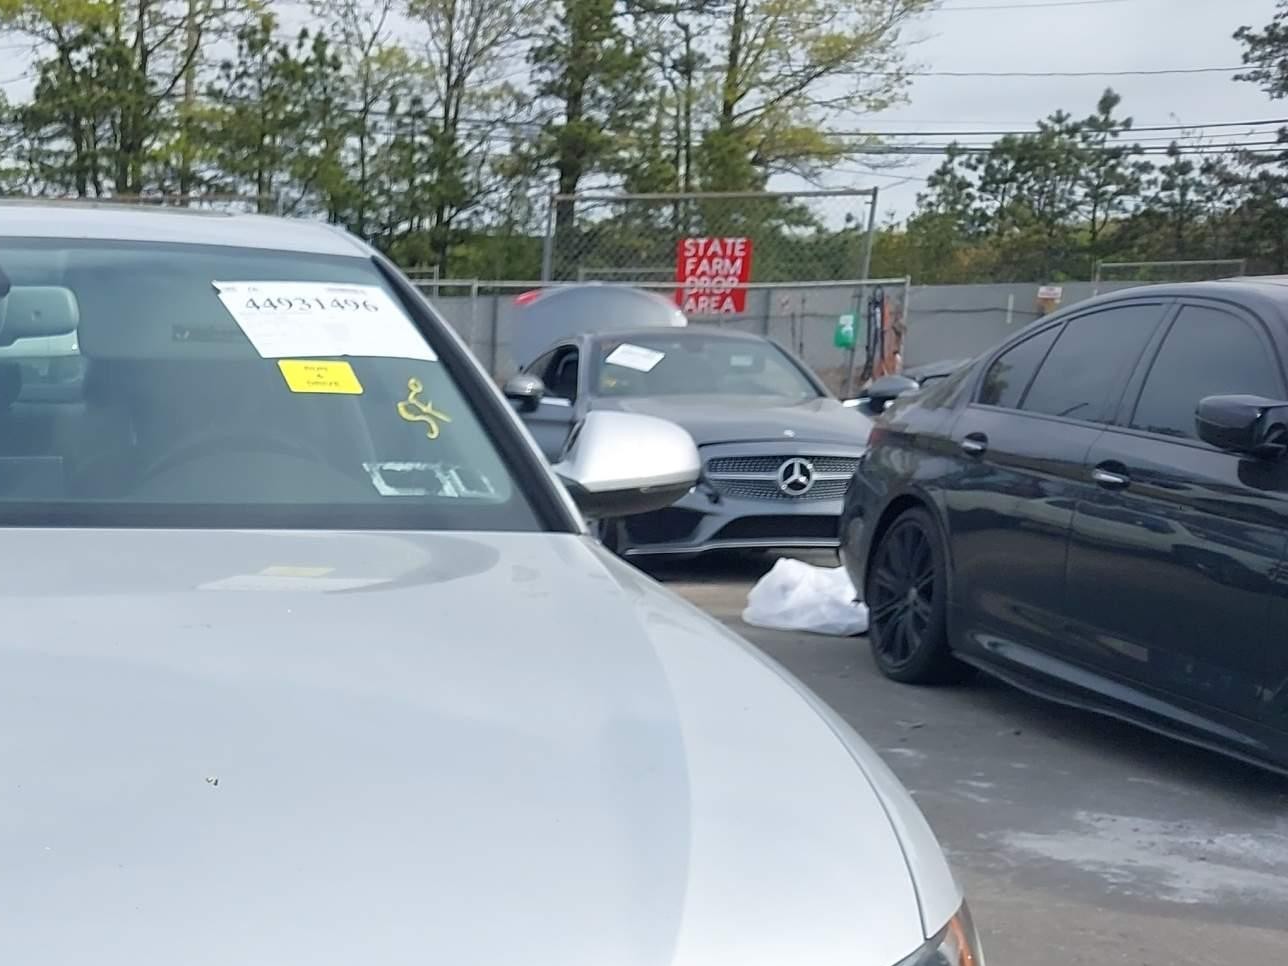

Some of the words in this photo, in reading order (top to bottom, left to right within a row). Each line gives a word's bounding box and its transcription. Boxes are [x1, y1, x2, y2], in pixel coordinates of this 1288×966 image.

[683, 238, 747, 257] STATE
[685, 257, 743, 276] FARM
[685, 275, 740, 295] DROP
[245, 297, 380, 313] 44931496
[683, 296, 737, 315] AREA
